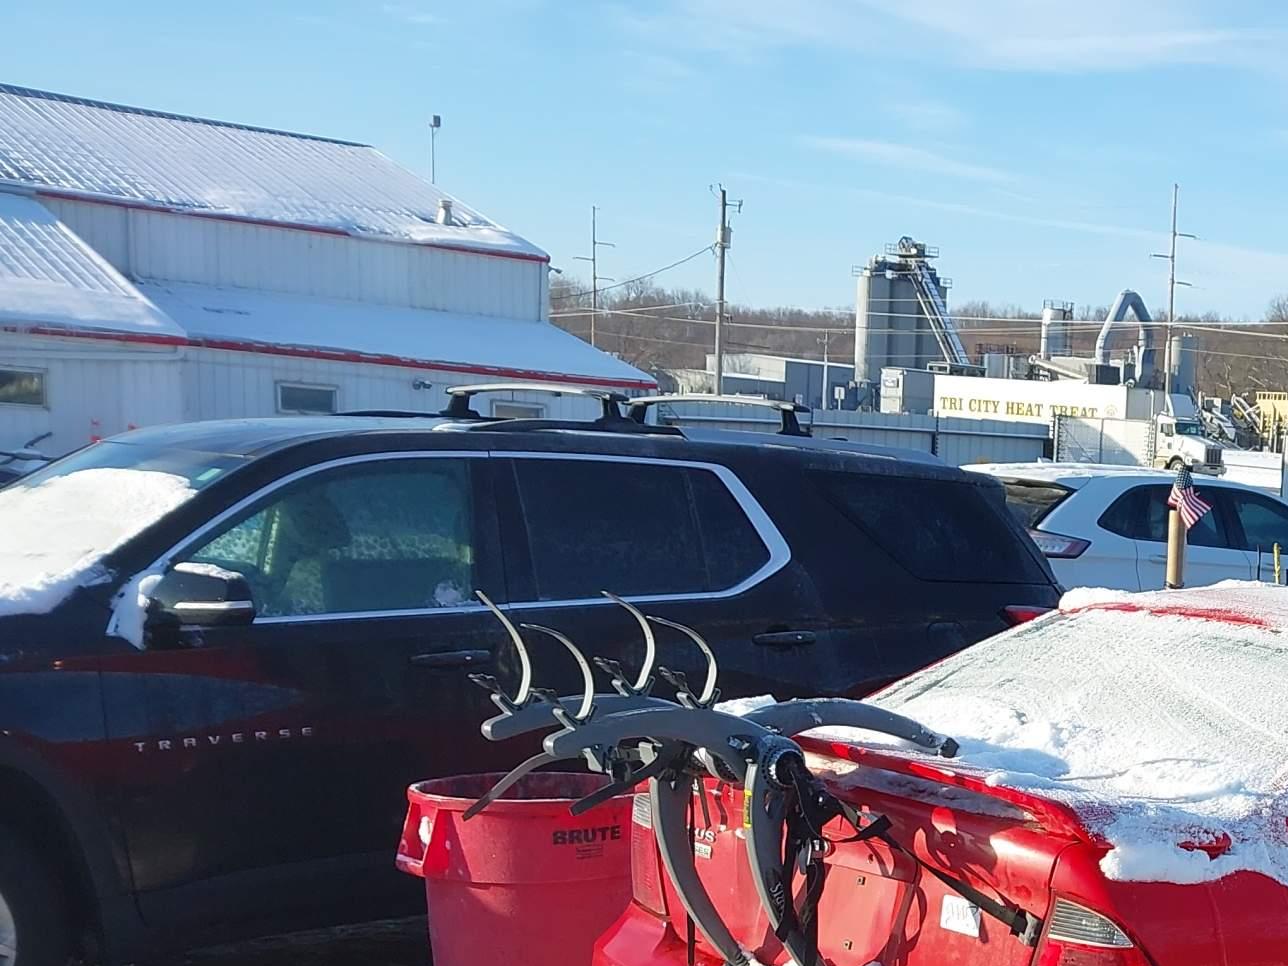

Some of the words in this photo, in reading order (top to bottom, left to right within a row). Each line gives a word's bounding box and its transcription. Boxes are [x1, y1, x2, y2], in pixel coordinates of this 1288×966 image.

[940, 396, 964, 411] TRI
[968, 398, 1000, 414] CITY
[1005, 401, 1044, 417] HEAT
[1049, 405, 1098, 418] TREAT
[133, 727, 313, 752] TRAVERSE
[552, 825, 622, 845] BRUTE
